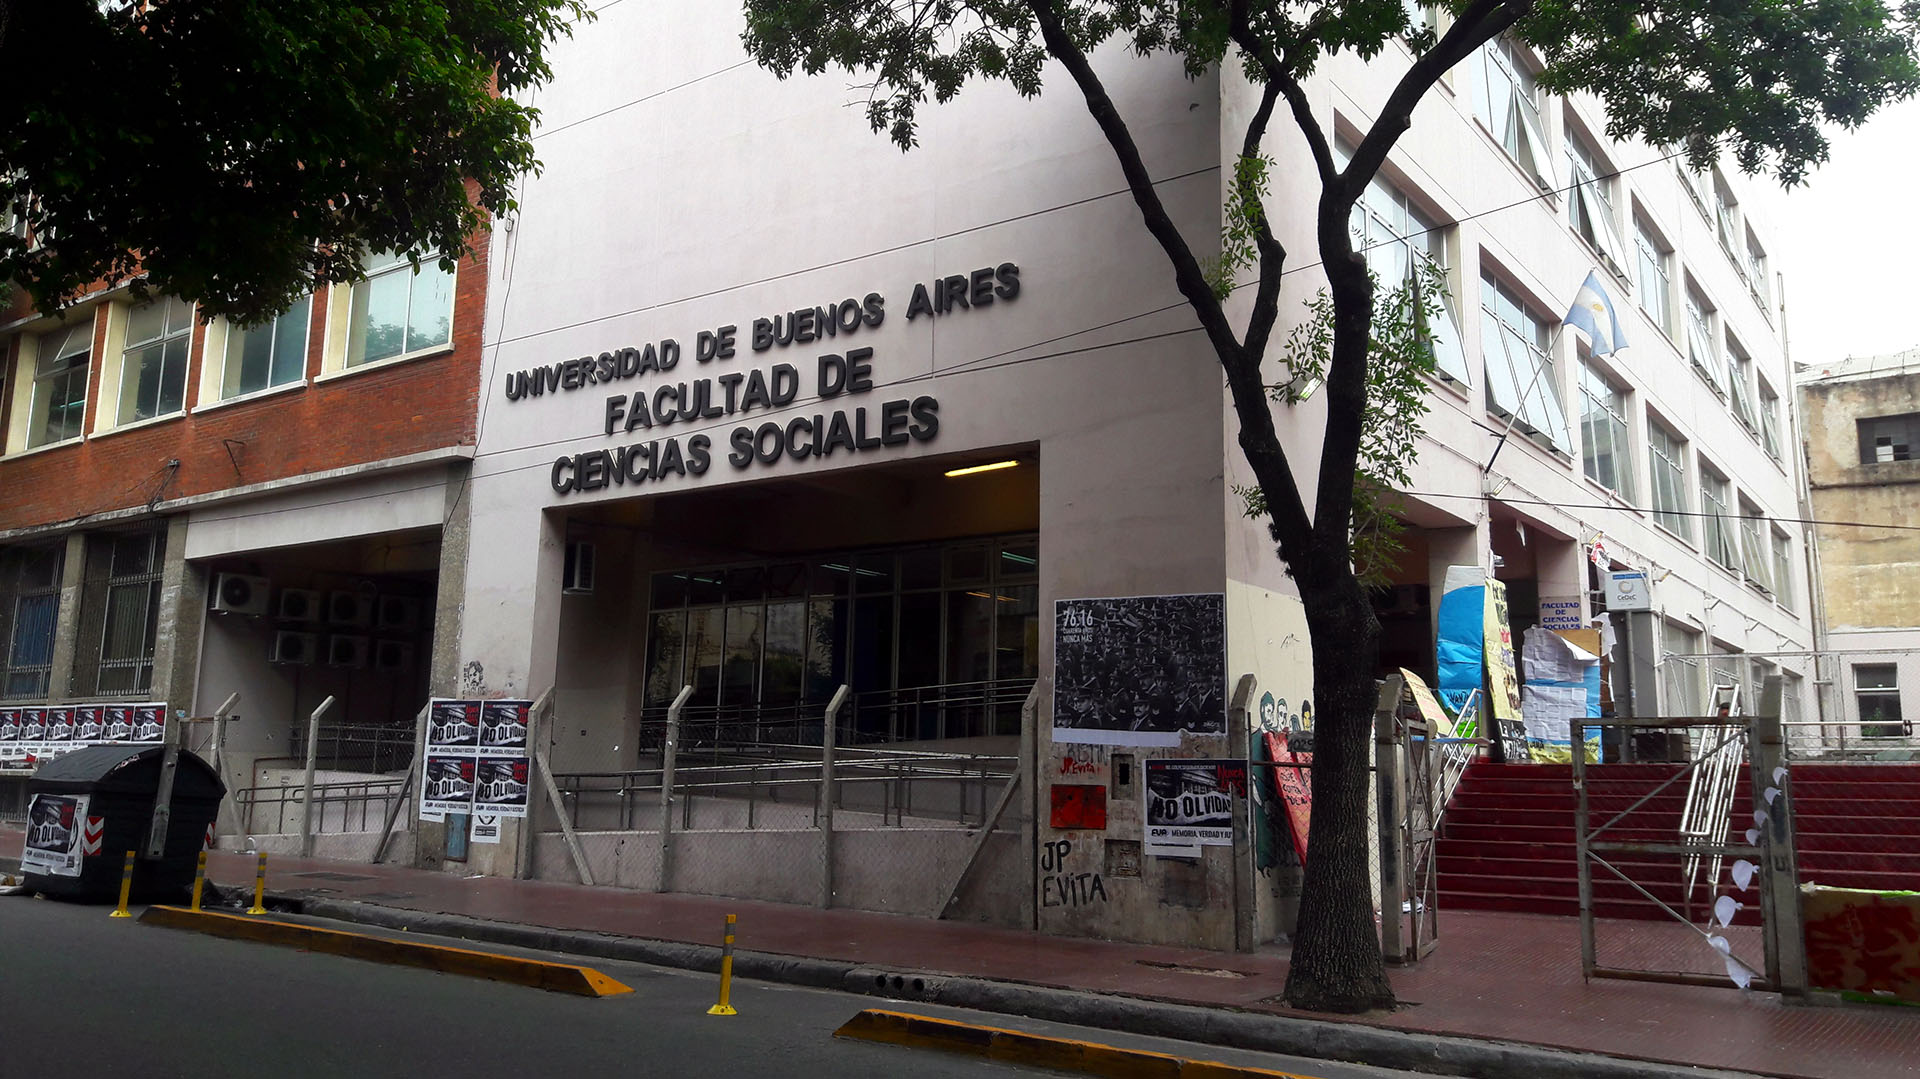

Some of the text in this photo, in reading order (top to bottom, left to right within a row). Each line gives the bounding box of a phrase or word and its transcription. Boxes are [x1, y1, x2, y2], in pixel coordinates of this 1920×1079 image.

[505, 263, 1021, 400] UNIVERSIDAD DE BUENOS AIRES
[605, 346, 874, 435] FACULTAD DE
[550, 395, 939, 495] CIENCIAS SOCIALES
[1150, 797, 1178, 820] NO
[1041, 840, 1072, 873] JP
